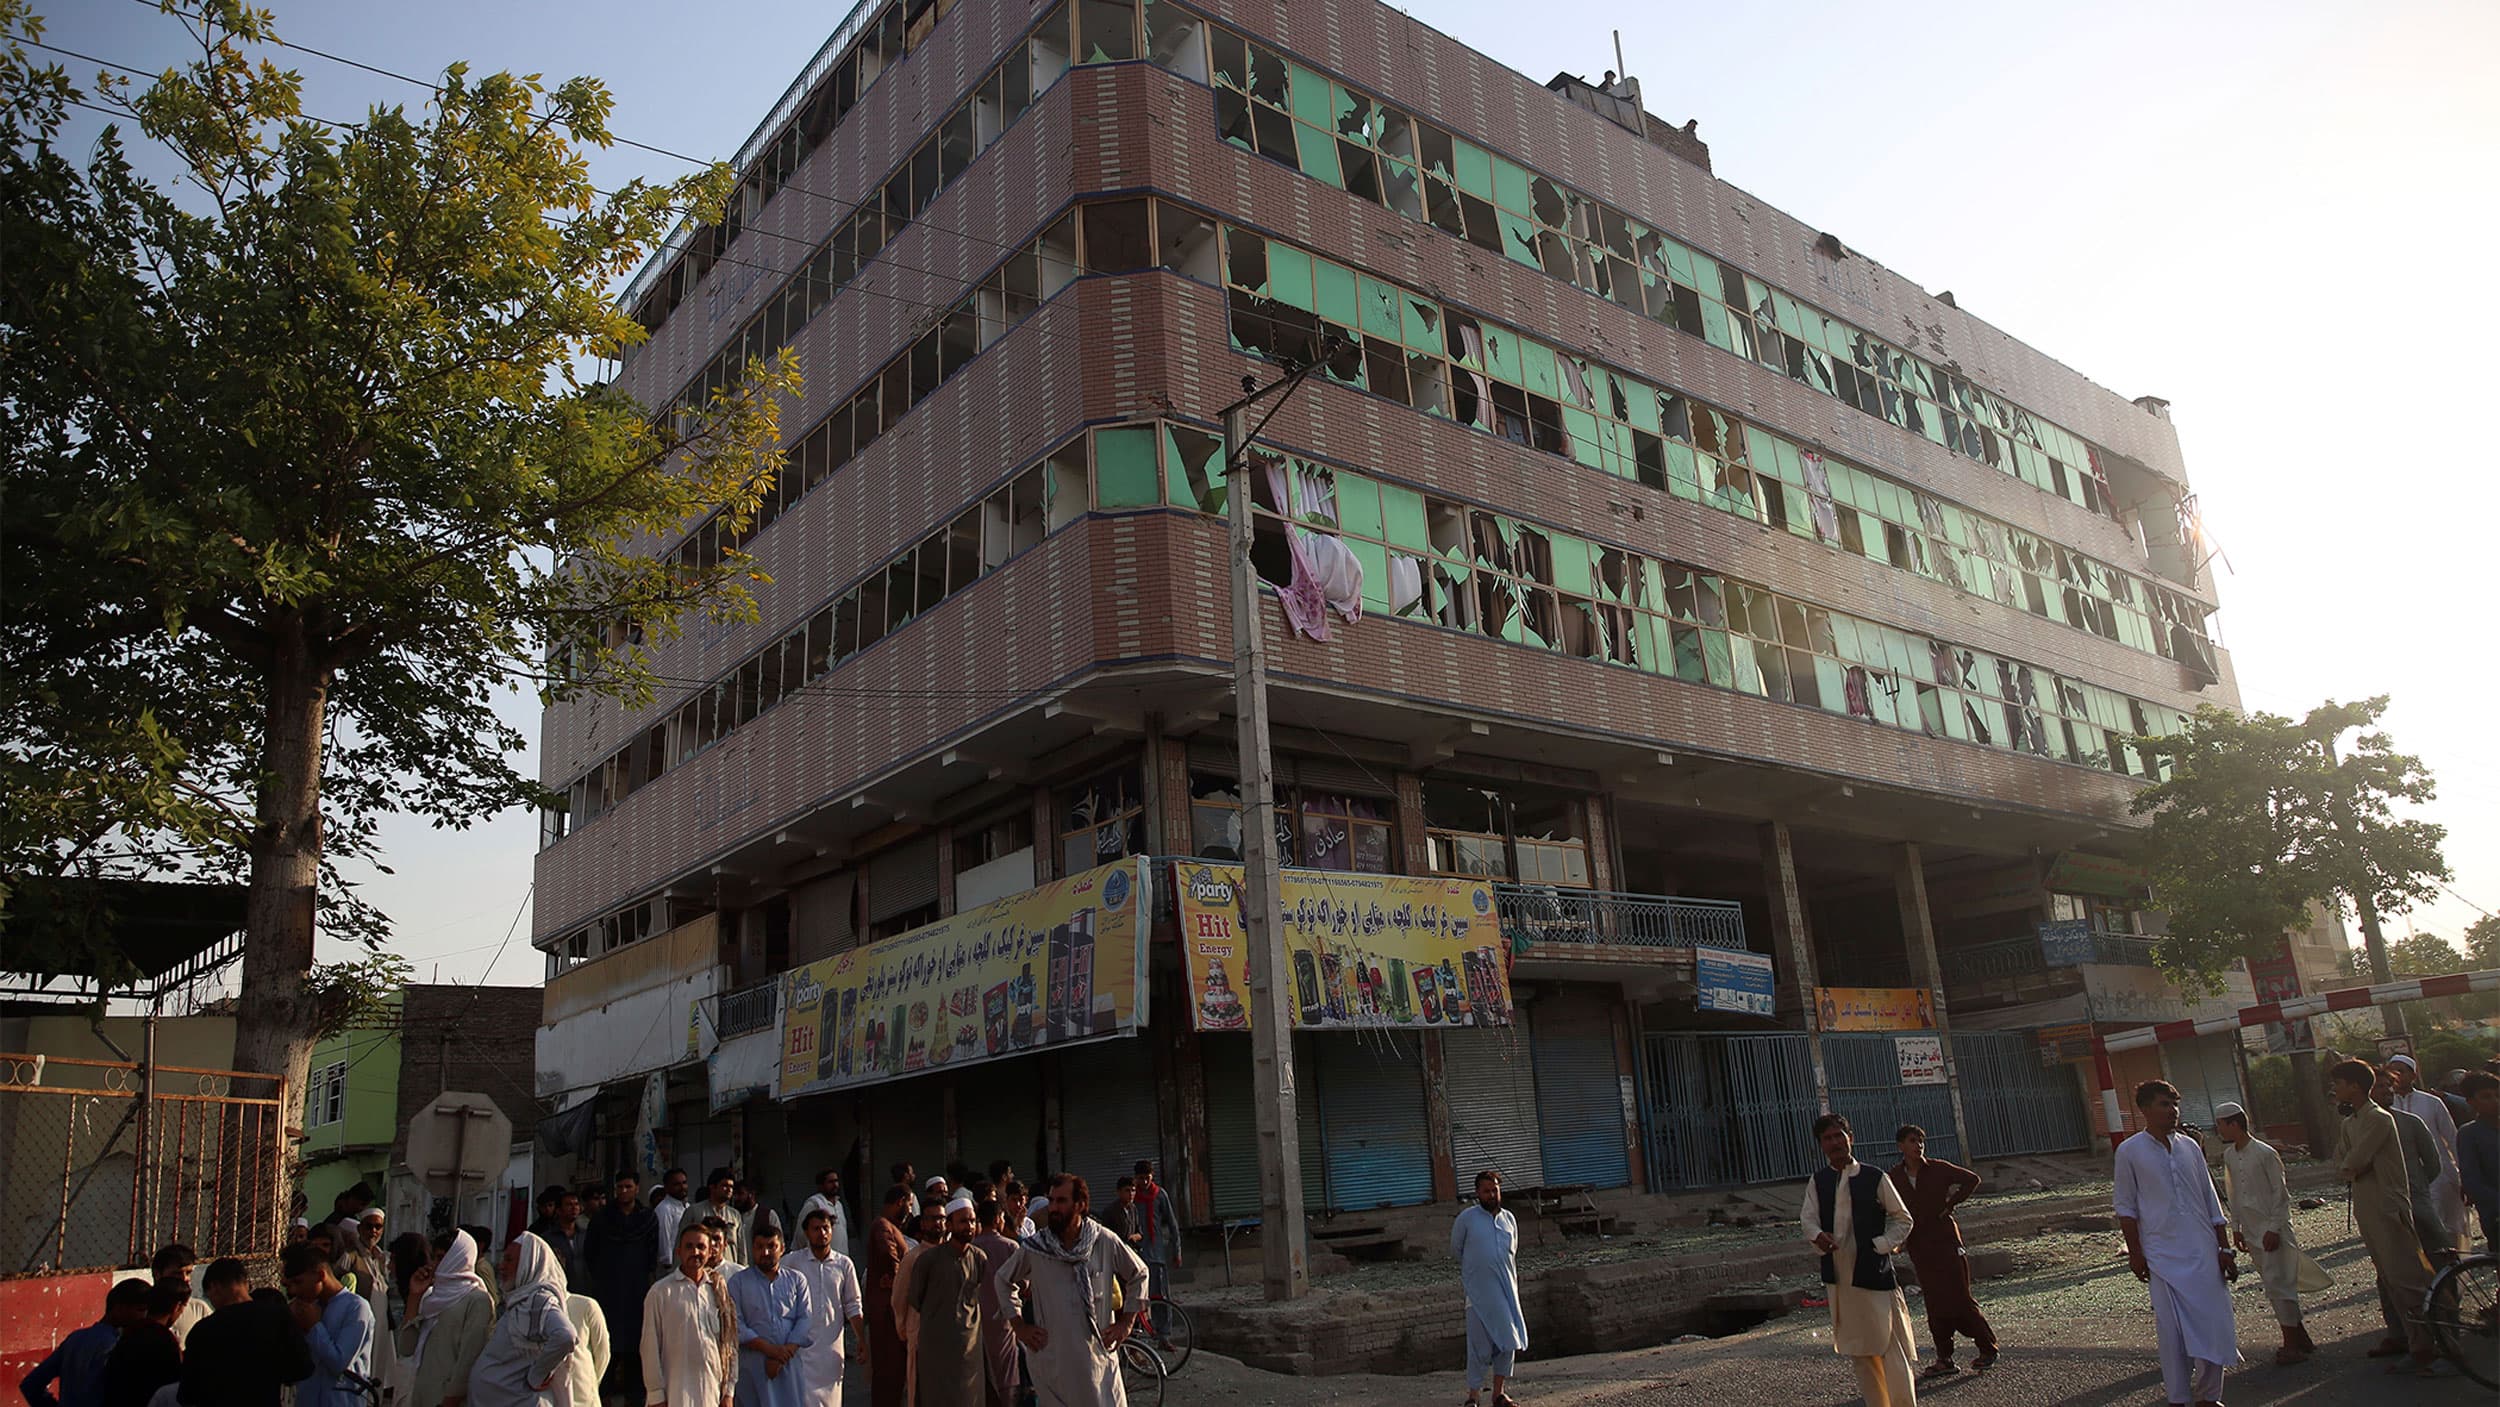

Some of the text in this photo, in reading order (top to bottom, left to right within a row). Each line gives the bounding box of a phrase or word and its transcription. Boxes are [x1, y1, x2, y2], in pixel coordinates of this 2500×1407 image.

[1314, 825, 1345, 857] صادق
[1197, 882, 1233, 902] party
[1196, 913, 1231, 938] Hit
[1198, 943, 1233, 957] Energy
[796, 980, 824, 1008] party
[790, 1025, 815, 1056] Hit
